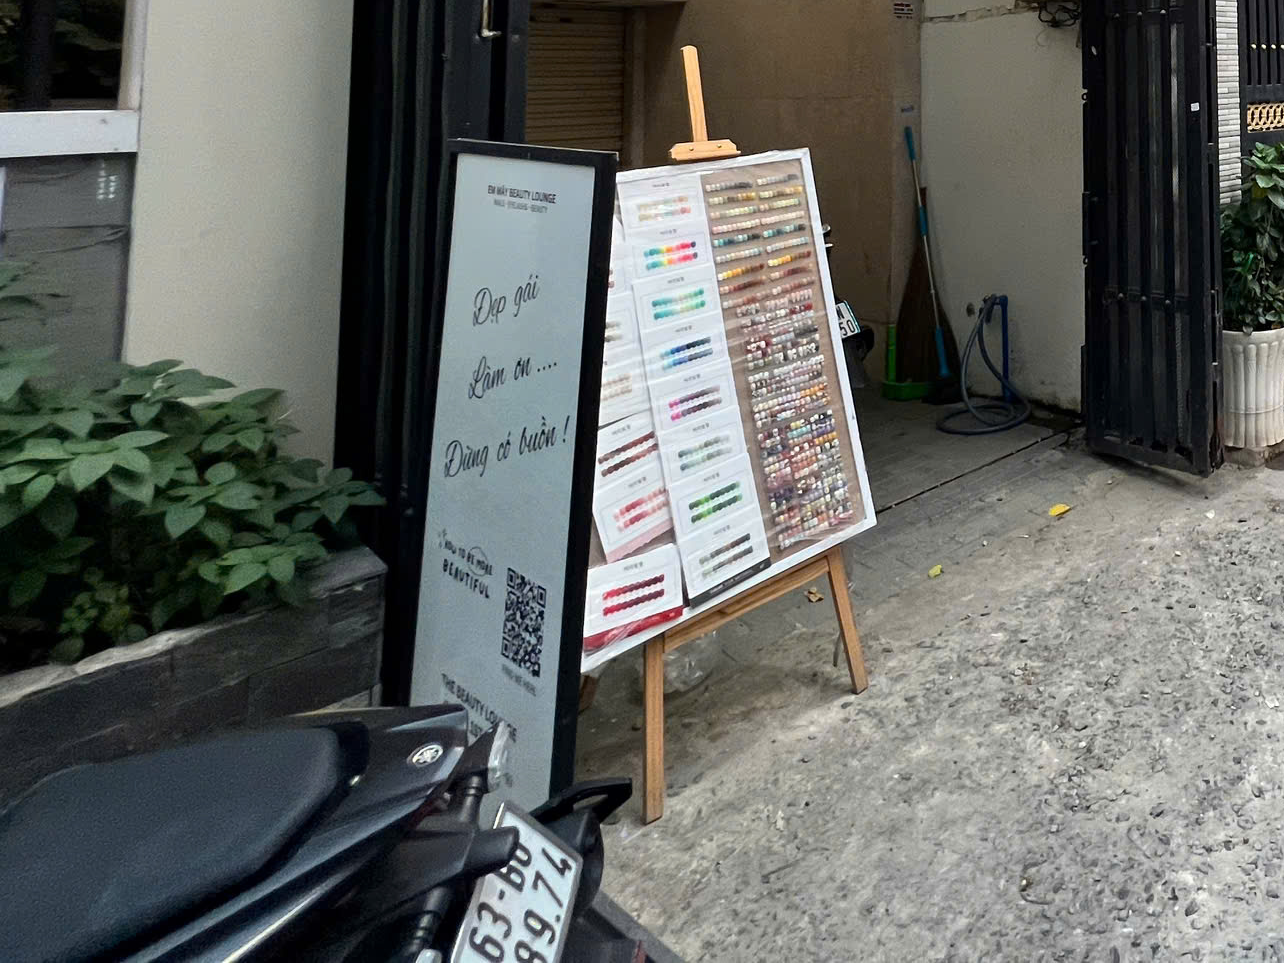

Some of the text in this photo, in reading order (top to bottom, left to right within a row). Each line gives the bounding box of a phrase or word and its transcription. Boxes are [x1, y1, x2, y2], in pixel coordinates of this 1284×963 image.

[509, 188, 531, 200] BEAUTY
[531, 191, 557, 204] LOUNGE
[473, 274, 540, 327] Đẹp gái
[468, 356, 506, 400] Làm
[497, 431, 511, 462] có
[443, 558, 490, 599] BEAUTIFUL
[456, 684, 485, 715] BEAUTY
